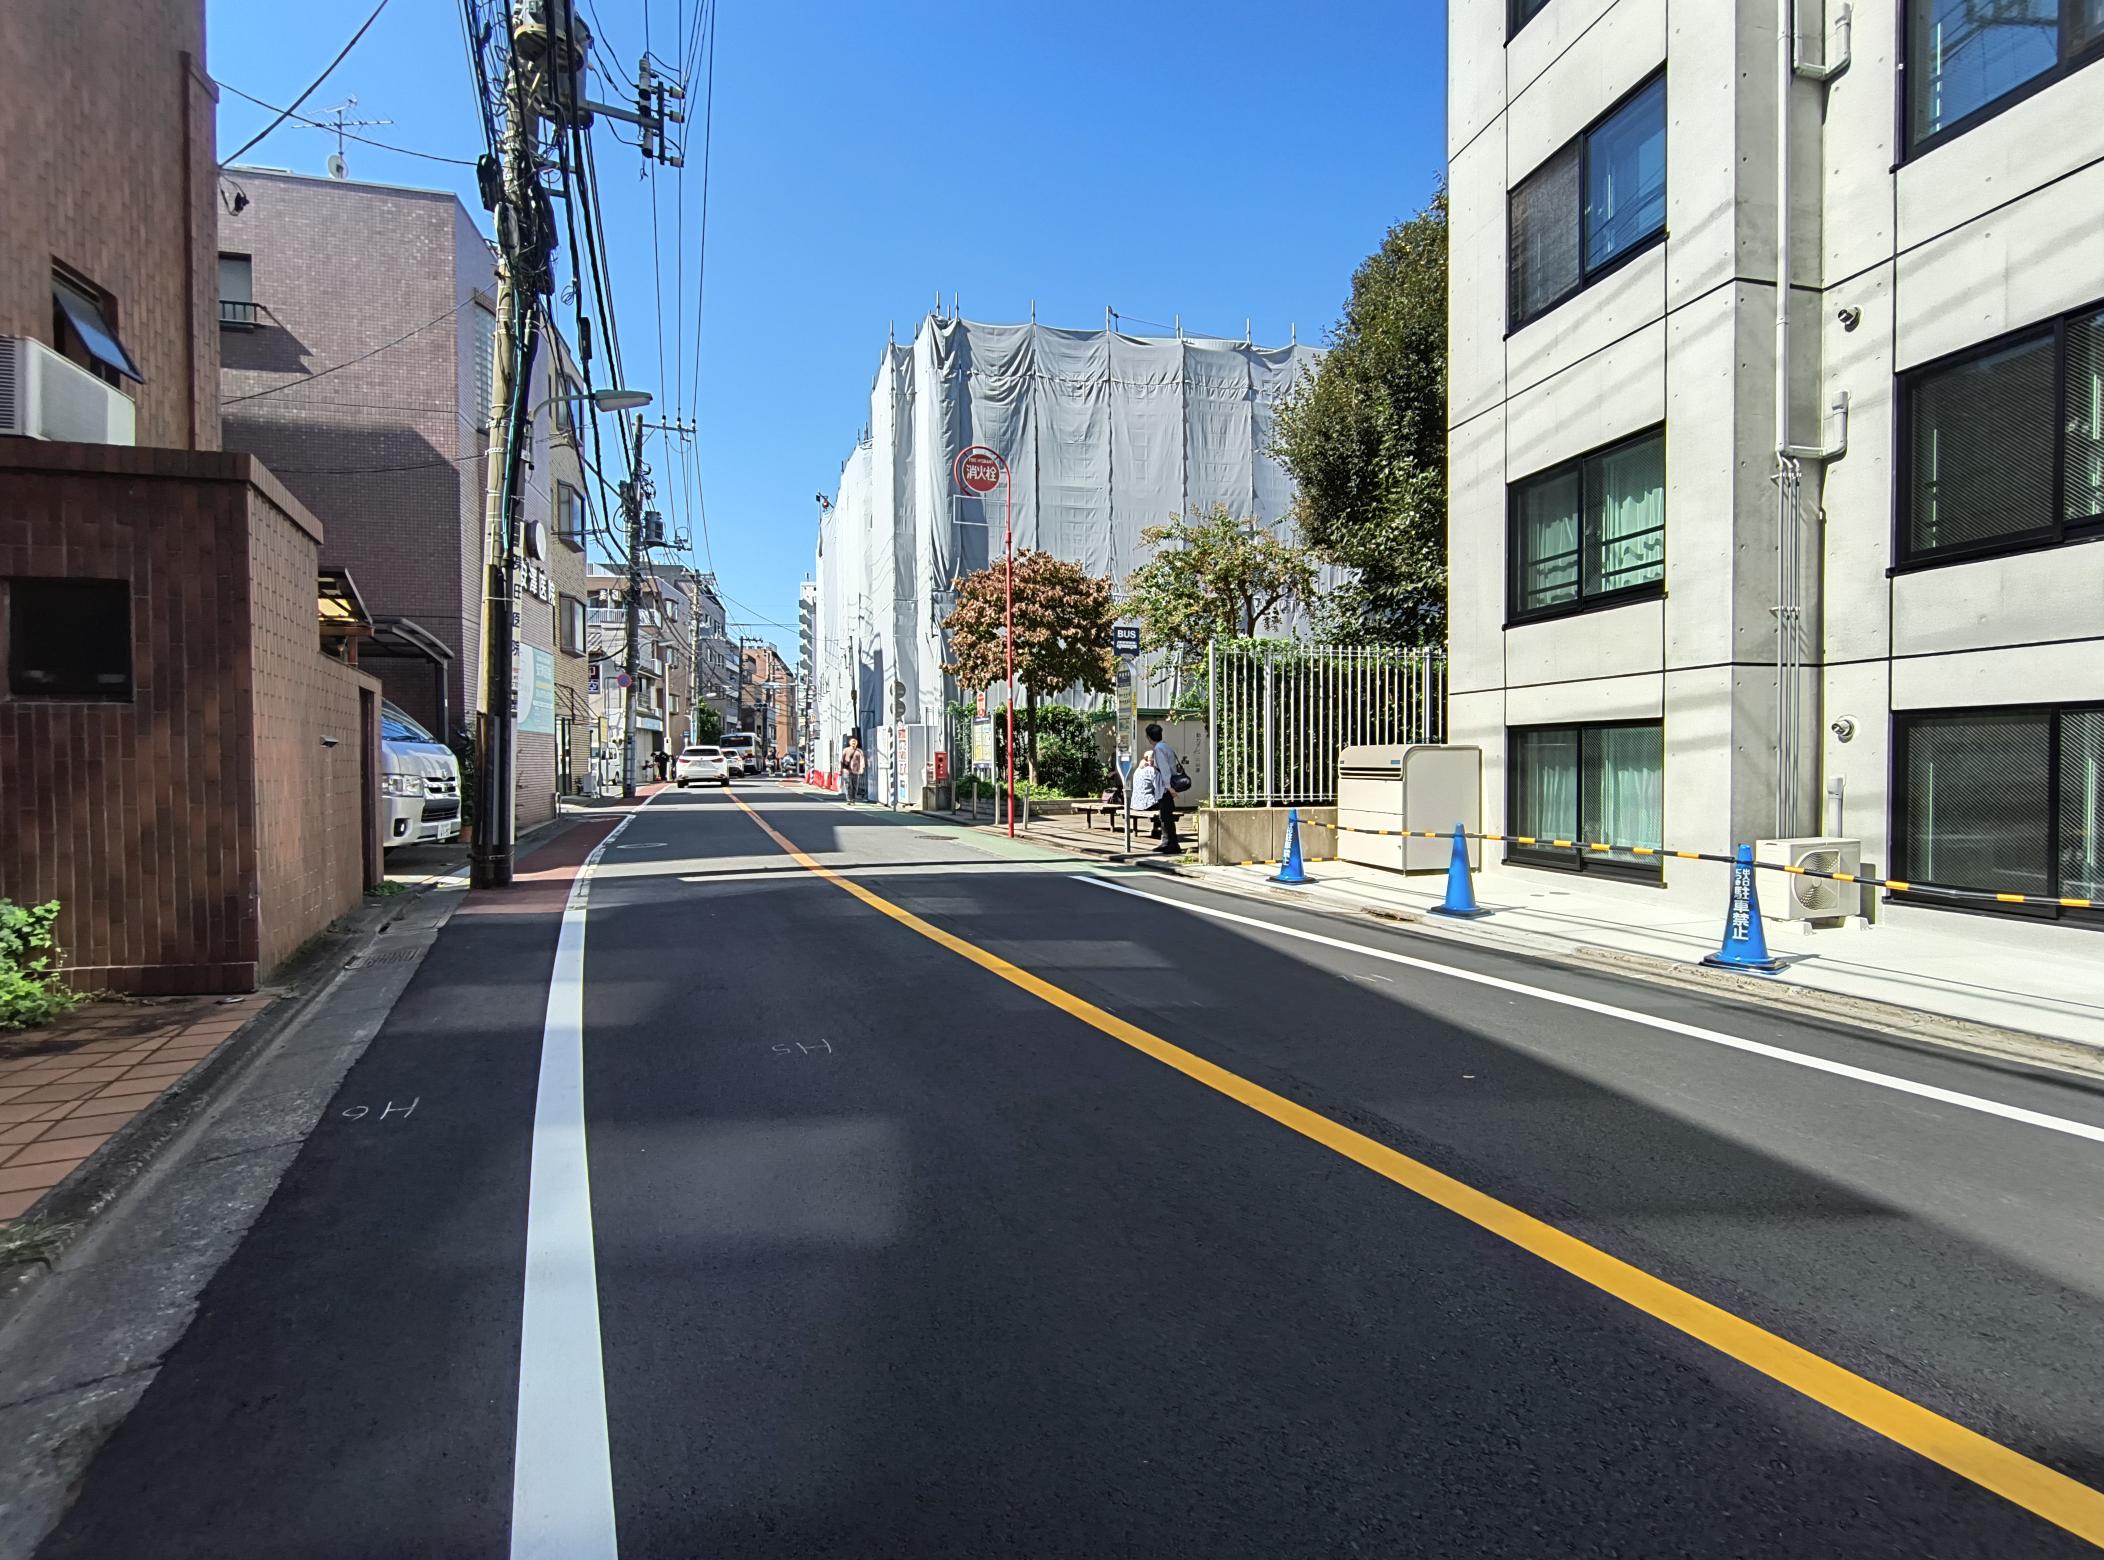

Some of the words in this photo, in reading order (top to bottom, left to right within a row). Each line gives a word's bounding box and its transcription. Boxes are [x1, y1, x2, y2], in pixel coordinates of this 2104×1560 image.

[966, 464, 997, 482] 消火栓
[1117, 630, 1136, 639] BUS
[1732, 886, 1750, 940] 駐車禁止
